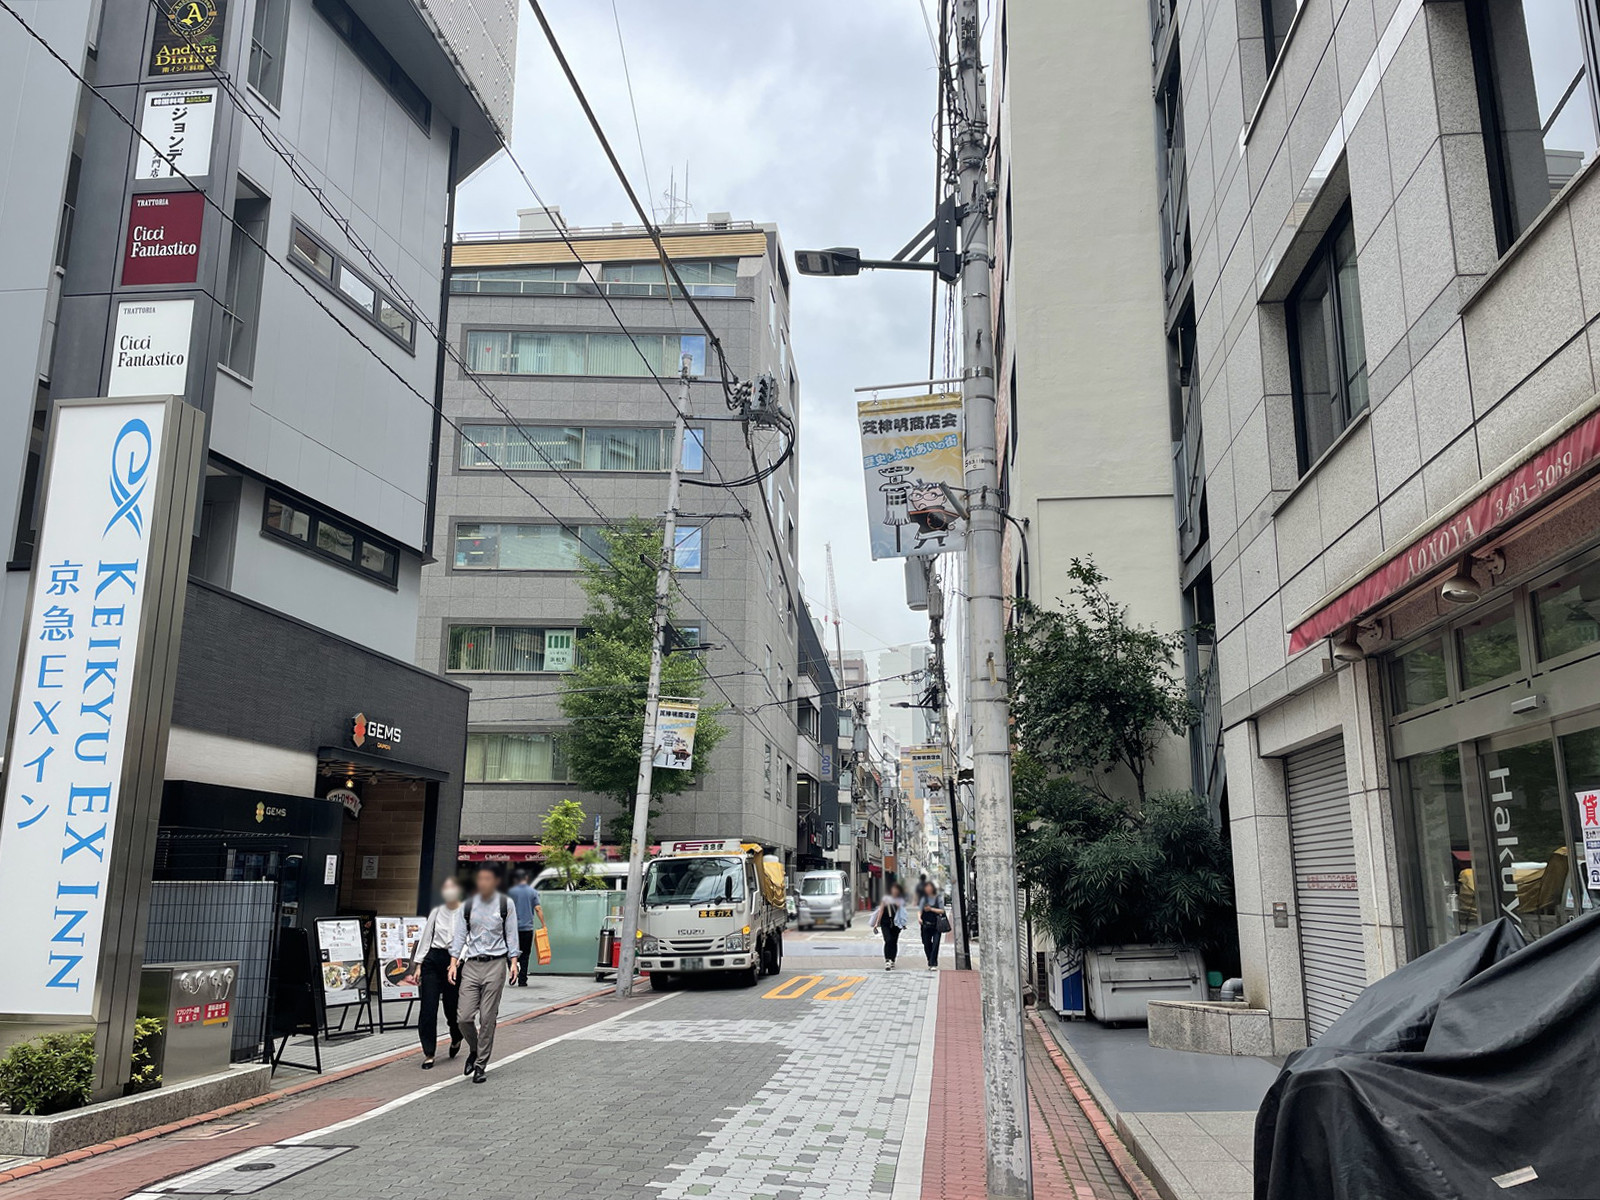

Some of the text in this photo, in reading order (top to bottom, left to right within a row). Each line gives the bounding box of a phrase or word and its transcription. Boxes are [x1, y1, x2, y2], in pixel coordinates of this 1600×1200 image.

[155, 43, 217, 56] Andhra
[155, 54, 217, 66] Dining
[137, 198, 169, 207] TRATTORIA
[133, 226, 165, 241] Cicci
[130, 241, 197, 258] Fantastico
[123, 306, 156, 315] TRATTORIA
[119, 335, 152, 350] Cicci
[117, 352, 184, 368] Fantastico
[862, 412, 958, 435] 芝神明商店会
[17, 560, 83, 829] 京急EXイン
[367, 721, 402, 743] GEMS
[45, 558, 139, 993] KEIKYU EX INN
[265, 806, 286, 817] GEMS
[1489, 767, 1524, 937] Hakuy
[700, 910, 732, 918] 高圧ガス
